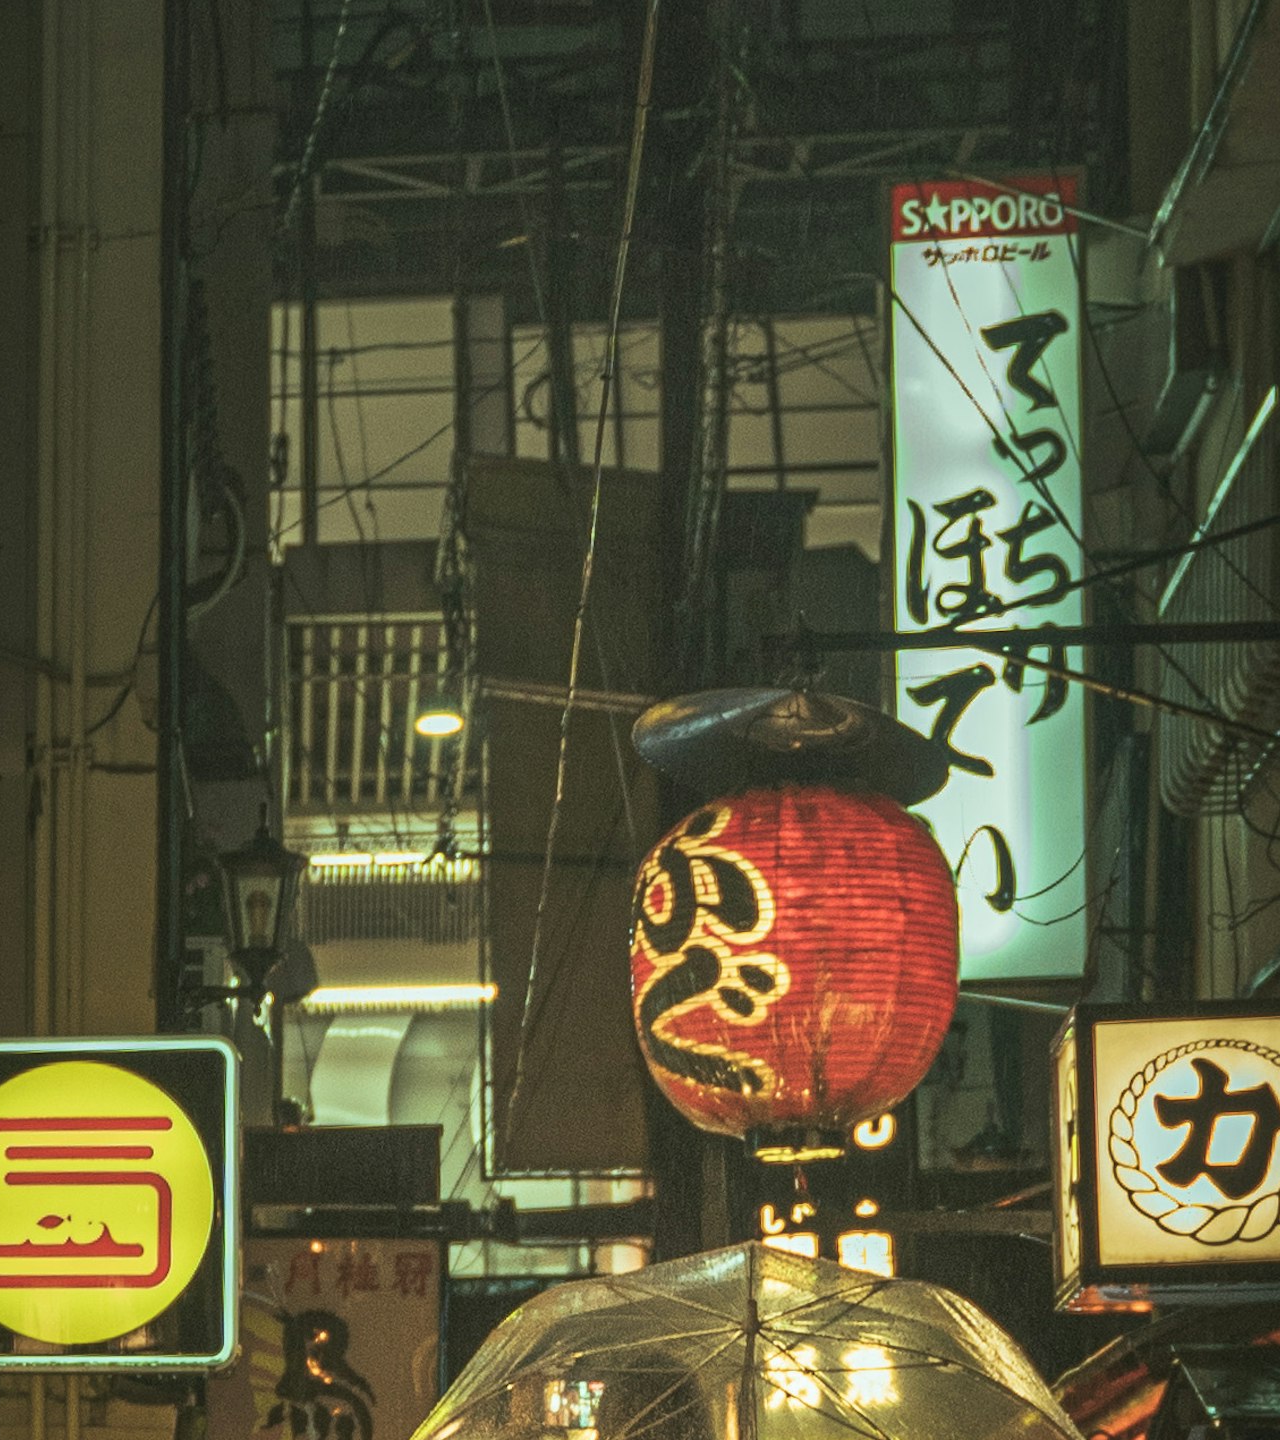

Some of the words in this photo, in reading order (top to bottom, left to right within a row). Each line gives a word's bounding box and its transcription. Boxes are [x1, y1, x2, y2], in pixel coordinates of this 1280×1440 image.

[923, 241, 1052, 268] サッポロビール
